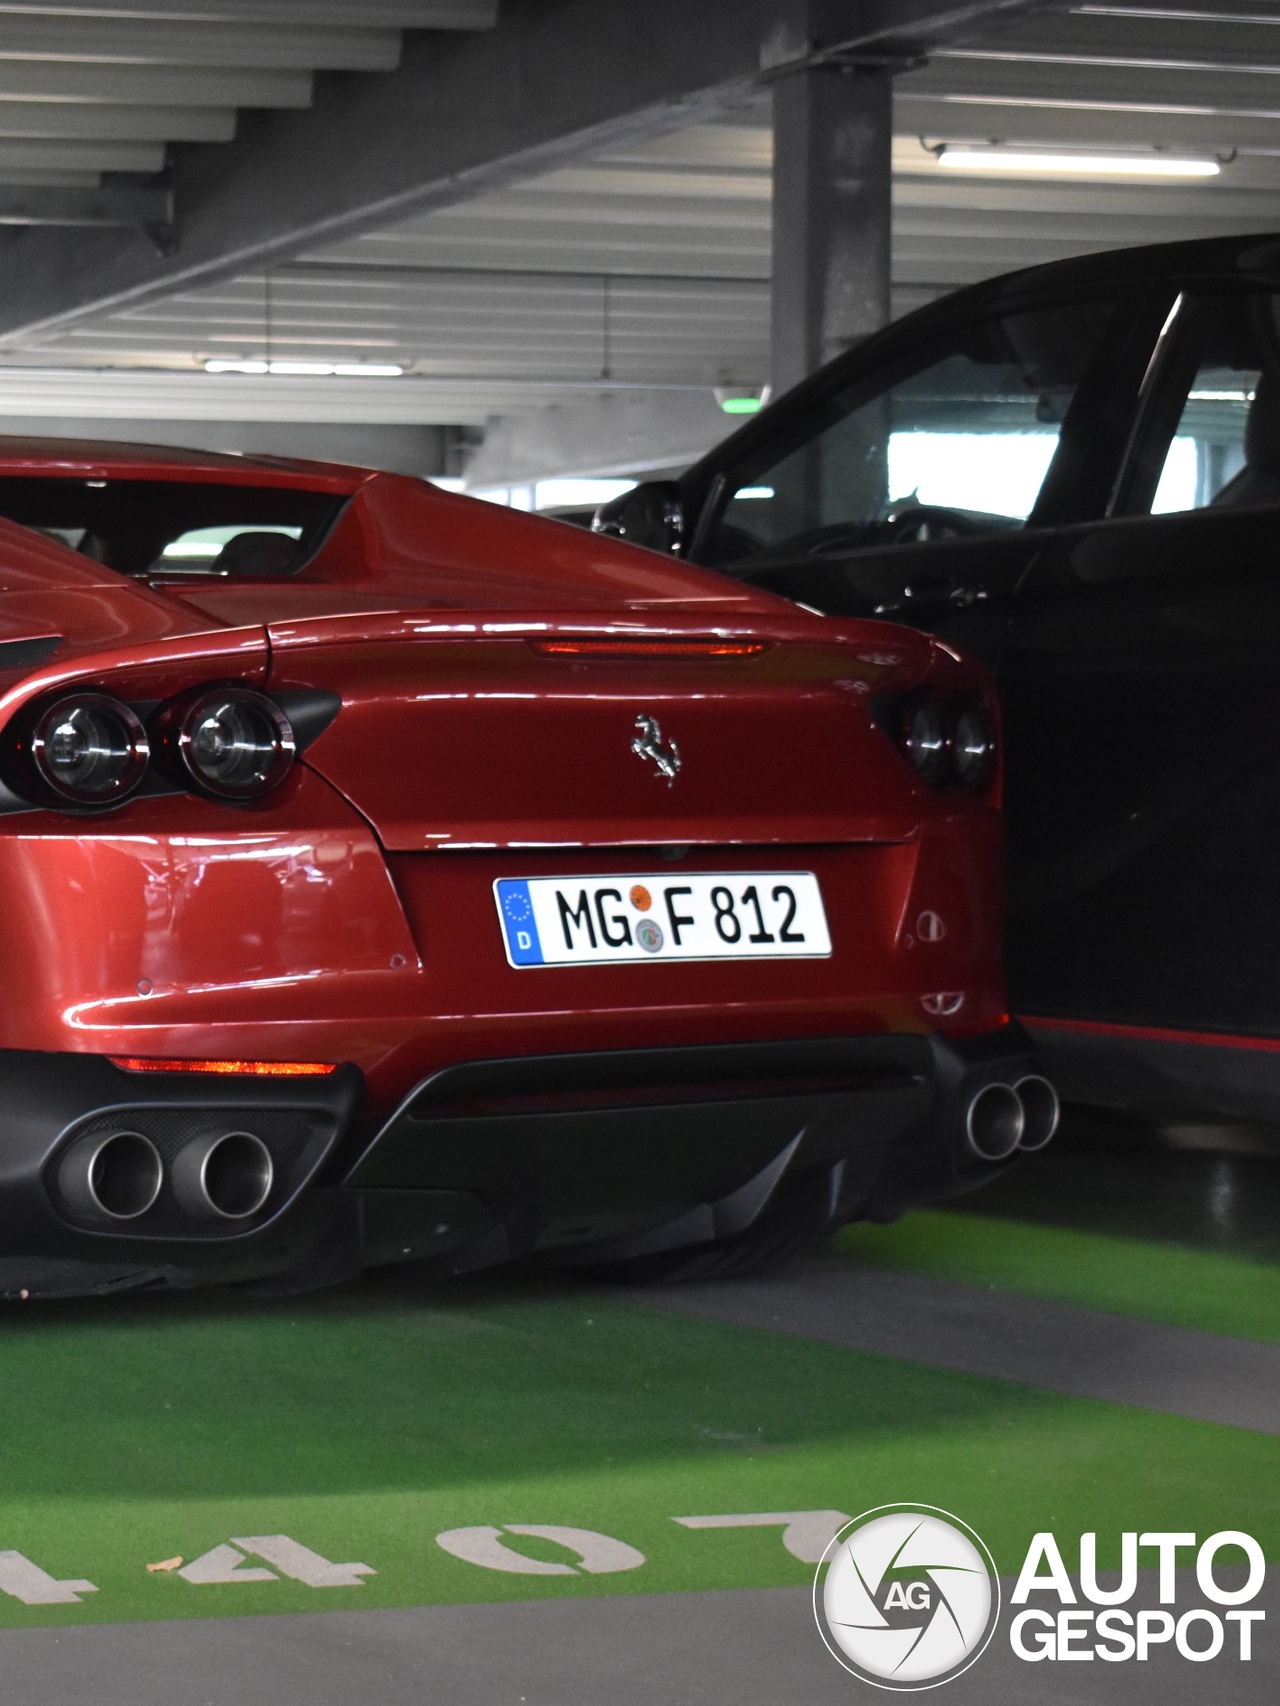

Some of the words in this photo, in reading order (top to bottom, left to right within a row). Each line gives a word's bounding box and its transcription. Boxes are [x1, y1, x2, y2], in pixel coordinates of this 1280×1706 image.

[555, 888, 632, 950] MG
[663, 886, 695, 946] F
[710, 884, 805, 945] 812
[518, 931, 532, 950] D
